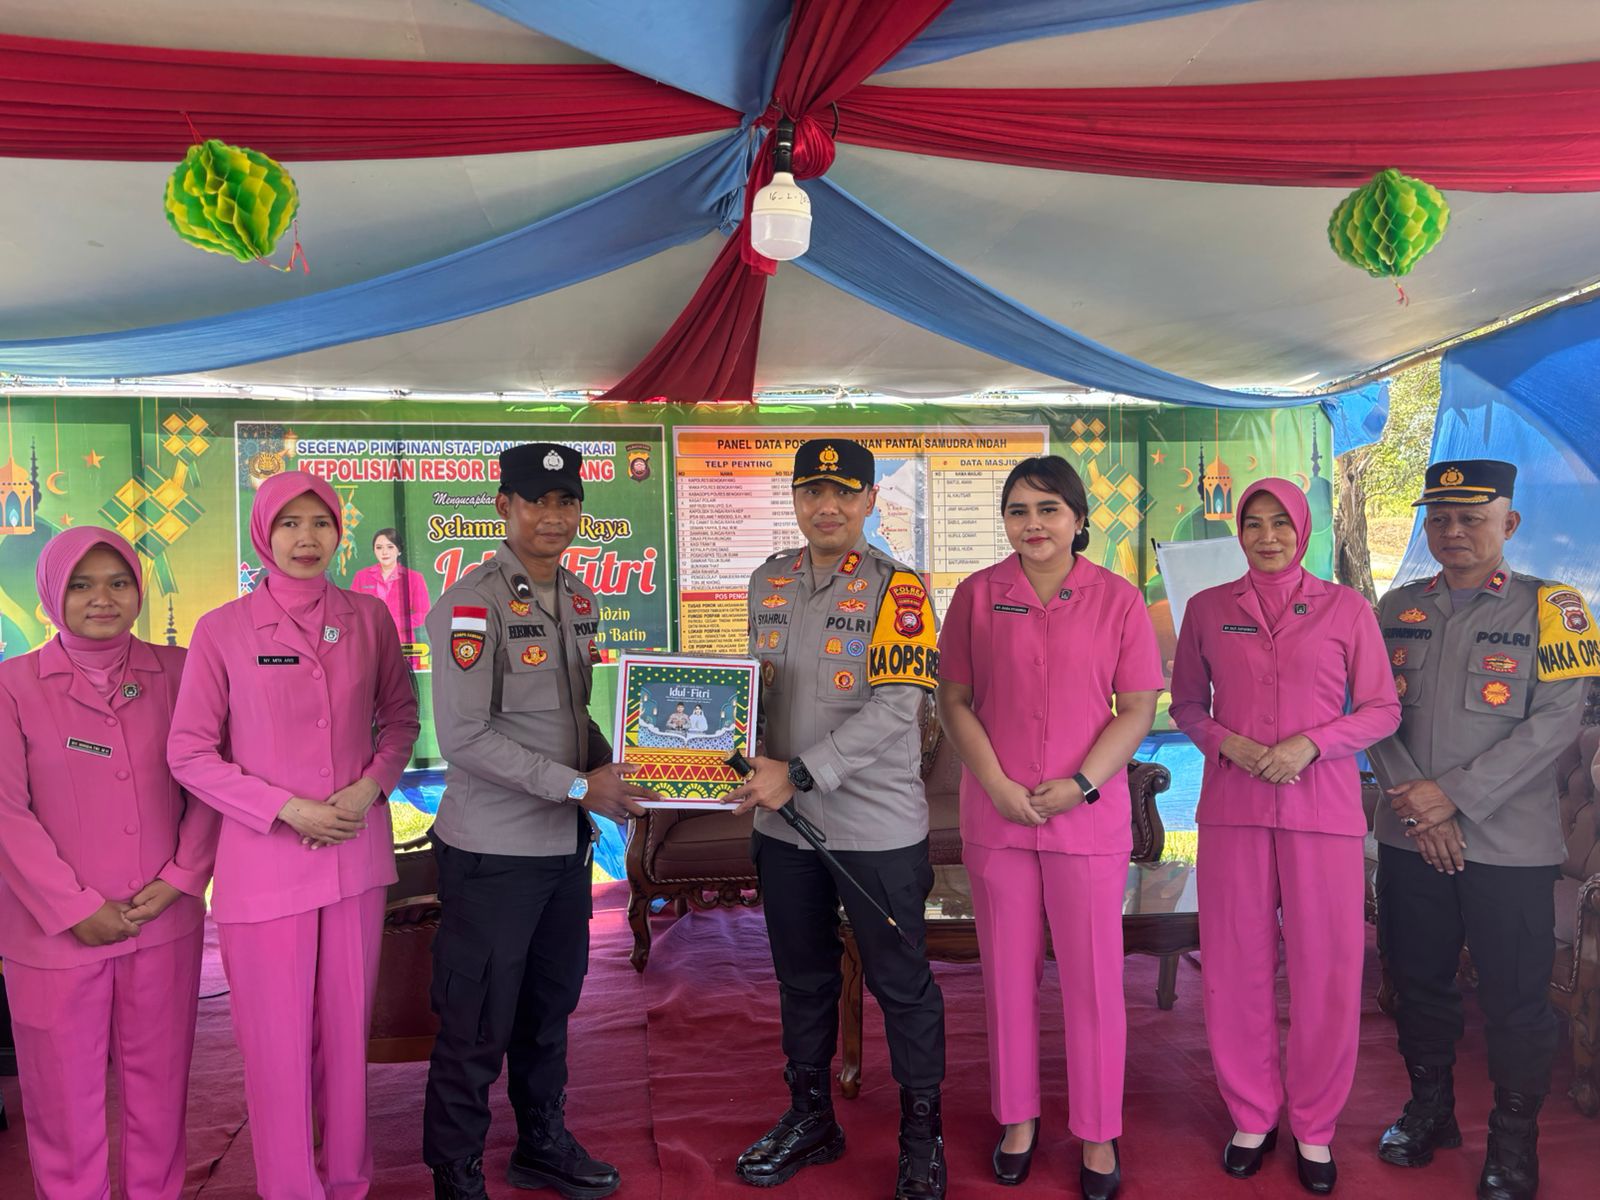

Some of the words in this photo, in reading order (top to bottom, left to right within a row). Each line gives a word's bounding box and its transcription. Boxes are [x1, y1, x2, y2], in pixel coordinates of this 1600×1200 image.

[297, 441, 367, 454] SEGENAP
[370, 441, 441, 454] PIMPINAN
[445, 441, 480, 454] STAF
[717, 439, 751, 449] PANEL
[755, 439, 778, 449] DATA
[785, 439, 806, 449] POS
[886, 438, 922, 448] PANTAI
[924, 438, 973, 448] SAMUDRA
[976, 438, 1007, 448] INDAH
[299, 459, 415, 481] KEPOLISIAN
[420, 459, 484, 481] RESOR
[705, 460, 728, 468] TELP
[731, 460, 773, 468] PENTING
[432, 491, 497, 509] Mengucapkan
[429, 514, 507, 542] Selama
[578, 514, 632, 543] Raya
[560, 546, 657, 595] Fitri
[758, 613, 788, 625] SYAHRUL
[826, 616, 871, 633] POLRI
[609, 628, 647, 643] Batin
[1476, 631, 1531, 647] POLRI
[889, 644, 925, 677] OPS
[1537, 641, 1580, 674] WAKA
[669, 687, 686, 697] Idul
[690, 688, 710, 699] Fitri
